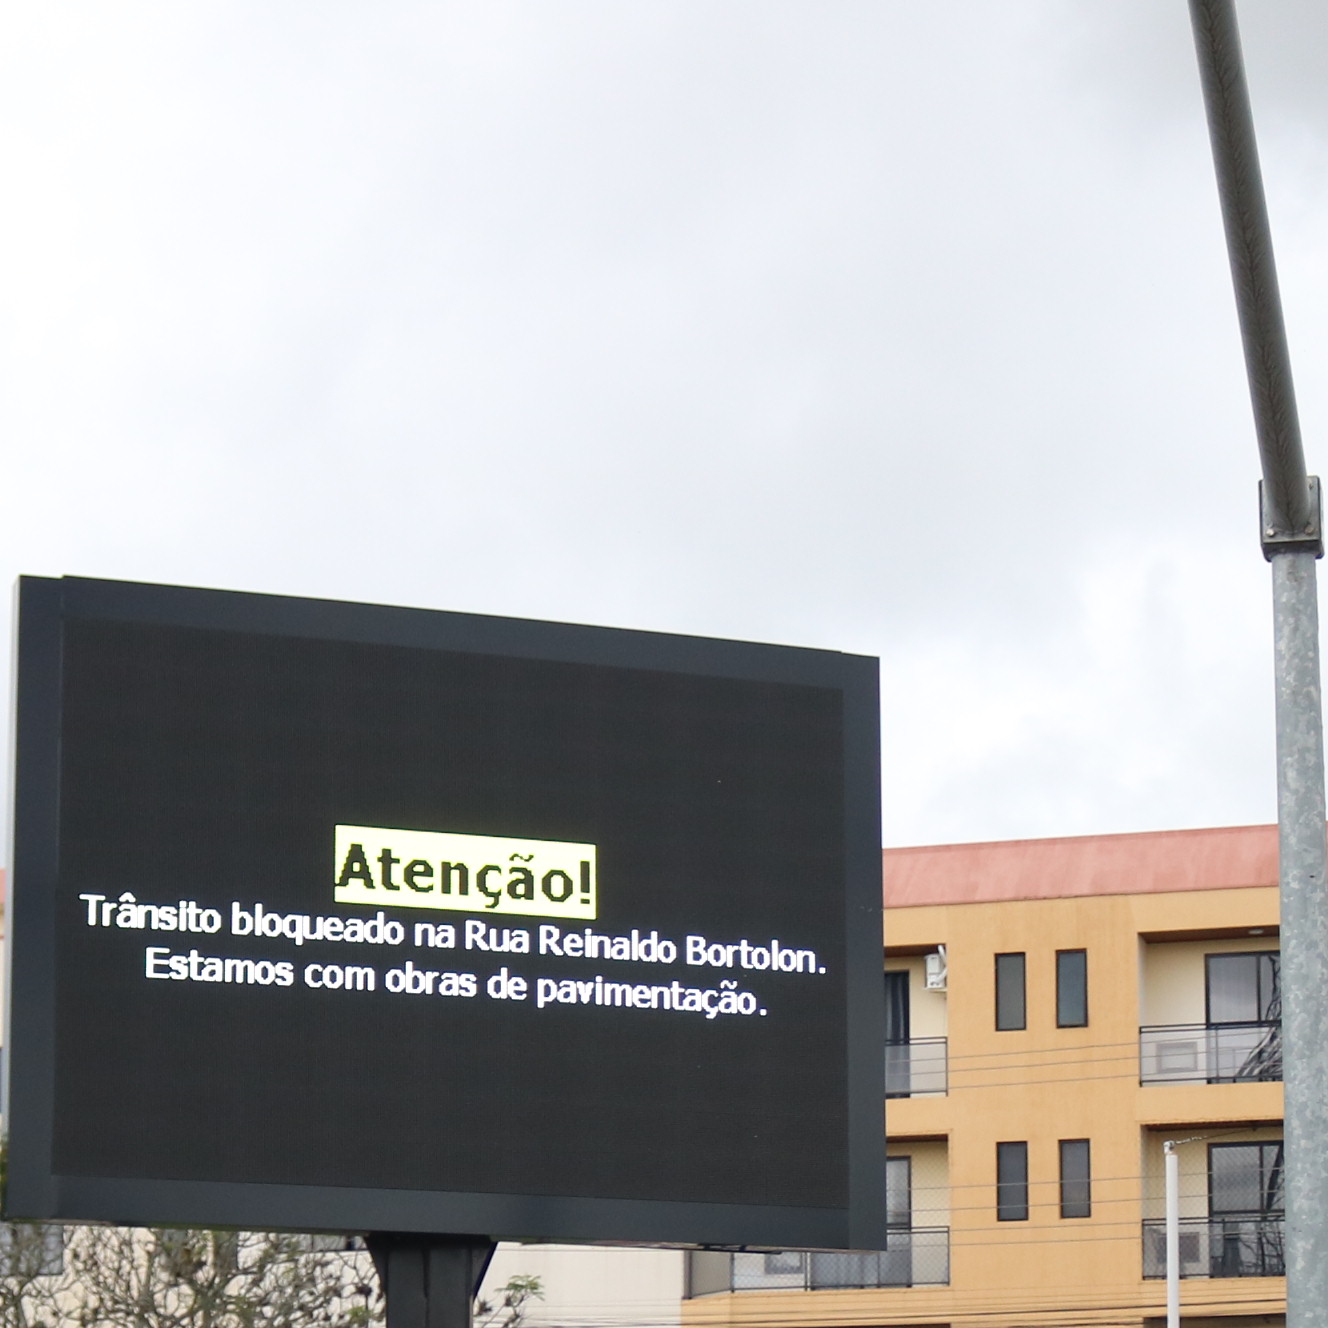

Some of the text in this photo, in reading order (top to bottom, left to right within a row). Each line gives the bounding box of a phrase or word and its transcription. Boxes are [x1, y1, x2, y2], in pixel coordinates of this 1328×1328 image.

[335, 842, 594, 909] Atenção!
[79, 891, 828, 975] Trânsito bloqueado na Rua Reinaldo Bortolon.
[145, 947, 768, 1020] Estamos com obras de pavimentação.
